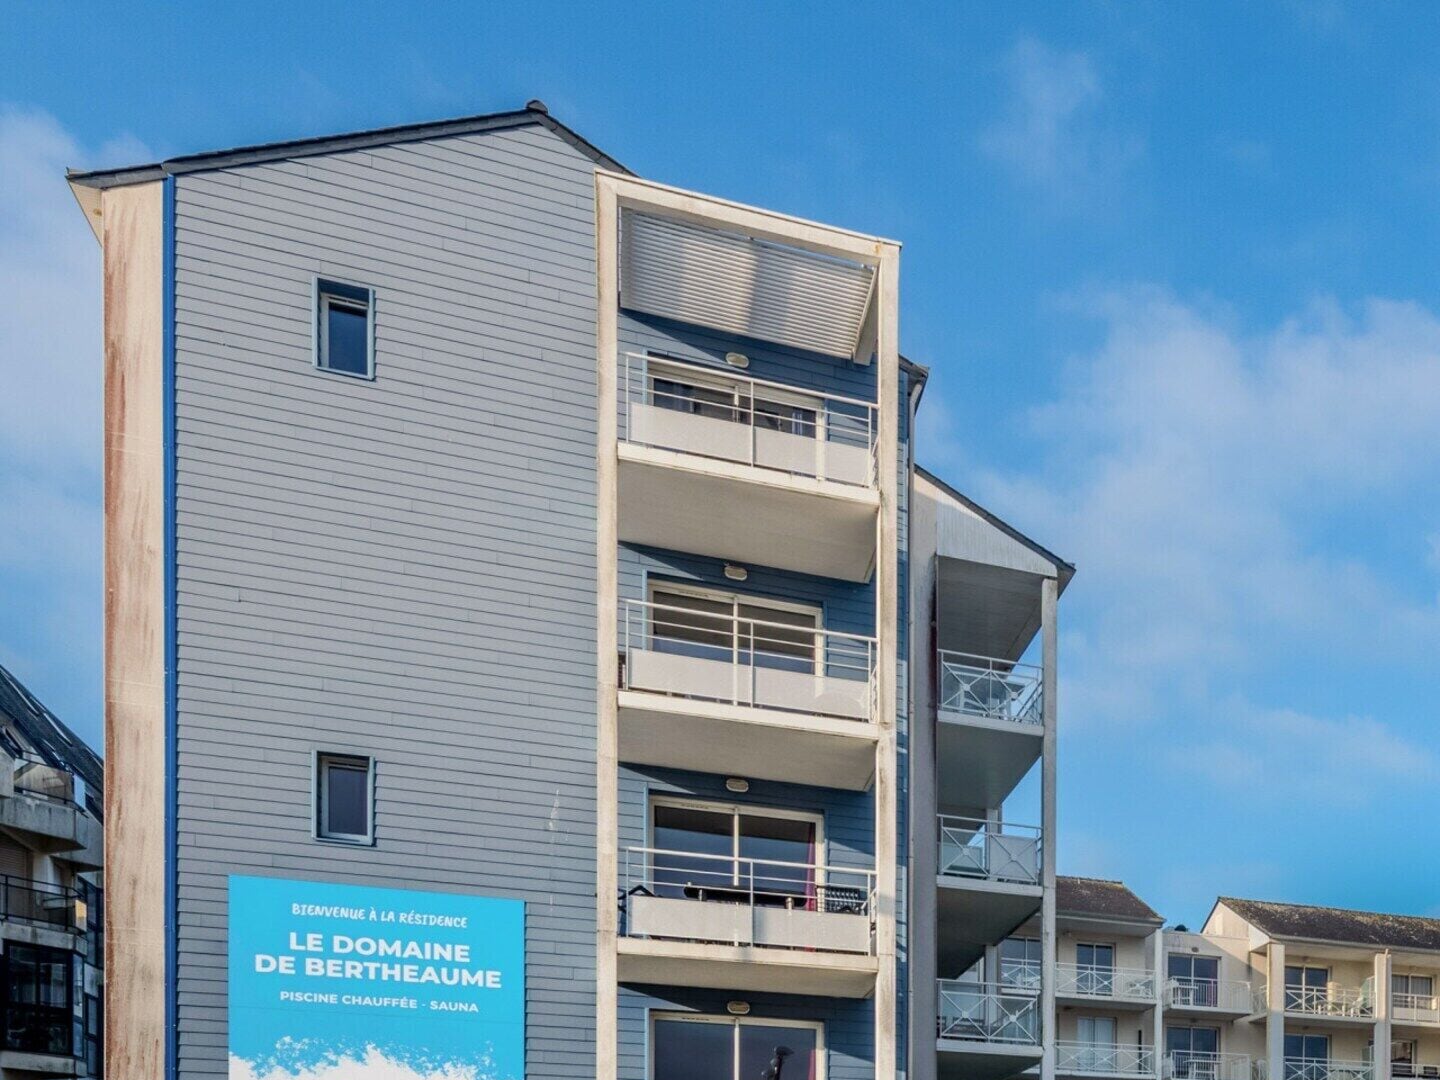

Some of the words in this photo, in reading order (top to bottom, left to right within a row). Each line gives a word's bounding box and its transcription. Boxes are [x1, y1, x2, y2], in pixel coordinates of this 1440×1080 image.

[291, 903, 365, 920] BIENVENUE
[368, 906, 377, 921] À
[380, 911, 395, 922] LA
[399, 911, 468, 928] RÉSIDENCE
[289, 931, 323, 951] LE
[332, 935, 470, 962] DOMAINE
[254, 954, 295, 974] DE
[305, 957, 502, 988] BERTHEAUME
[280, 990, 338, 1004] PISCINE
[342, 994, 417, 1009] CHAUFFÉE
[430, 1000, 479, 1012] SAUNA
